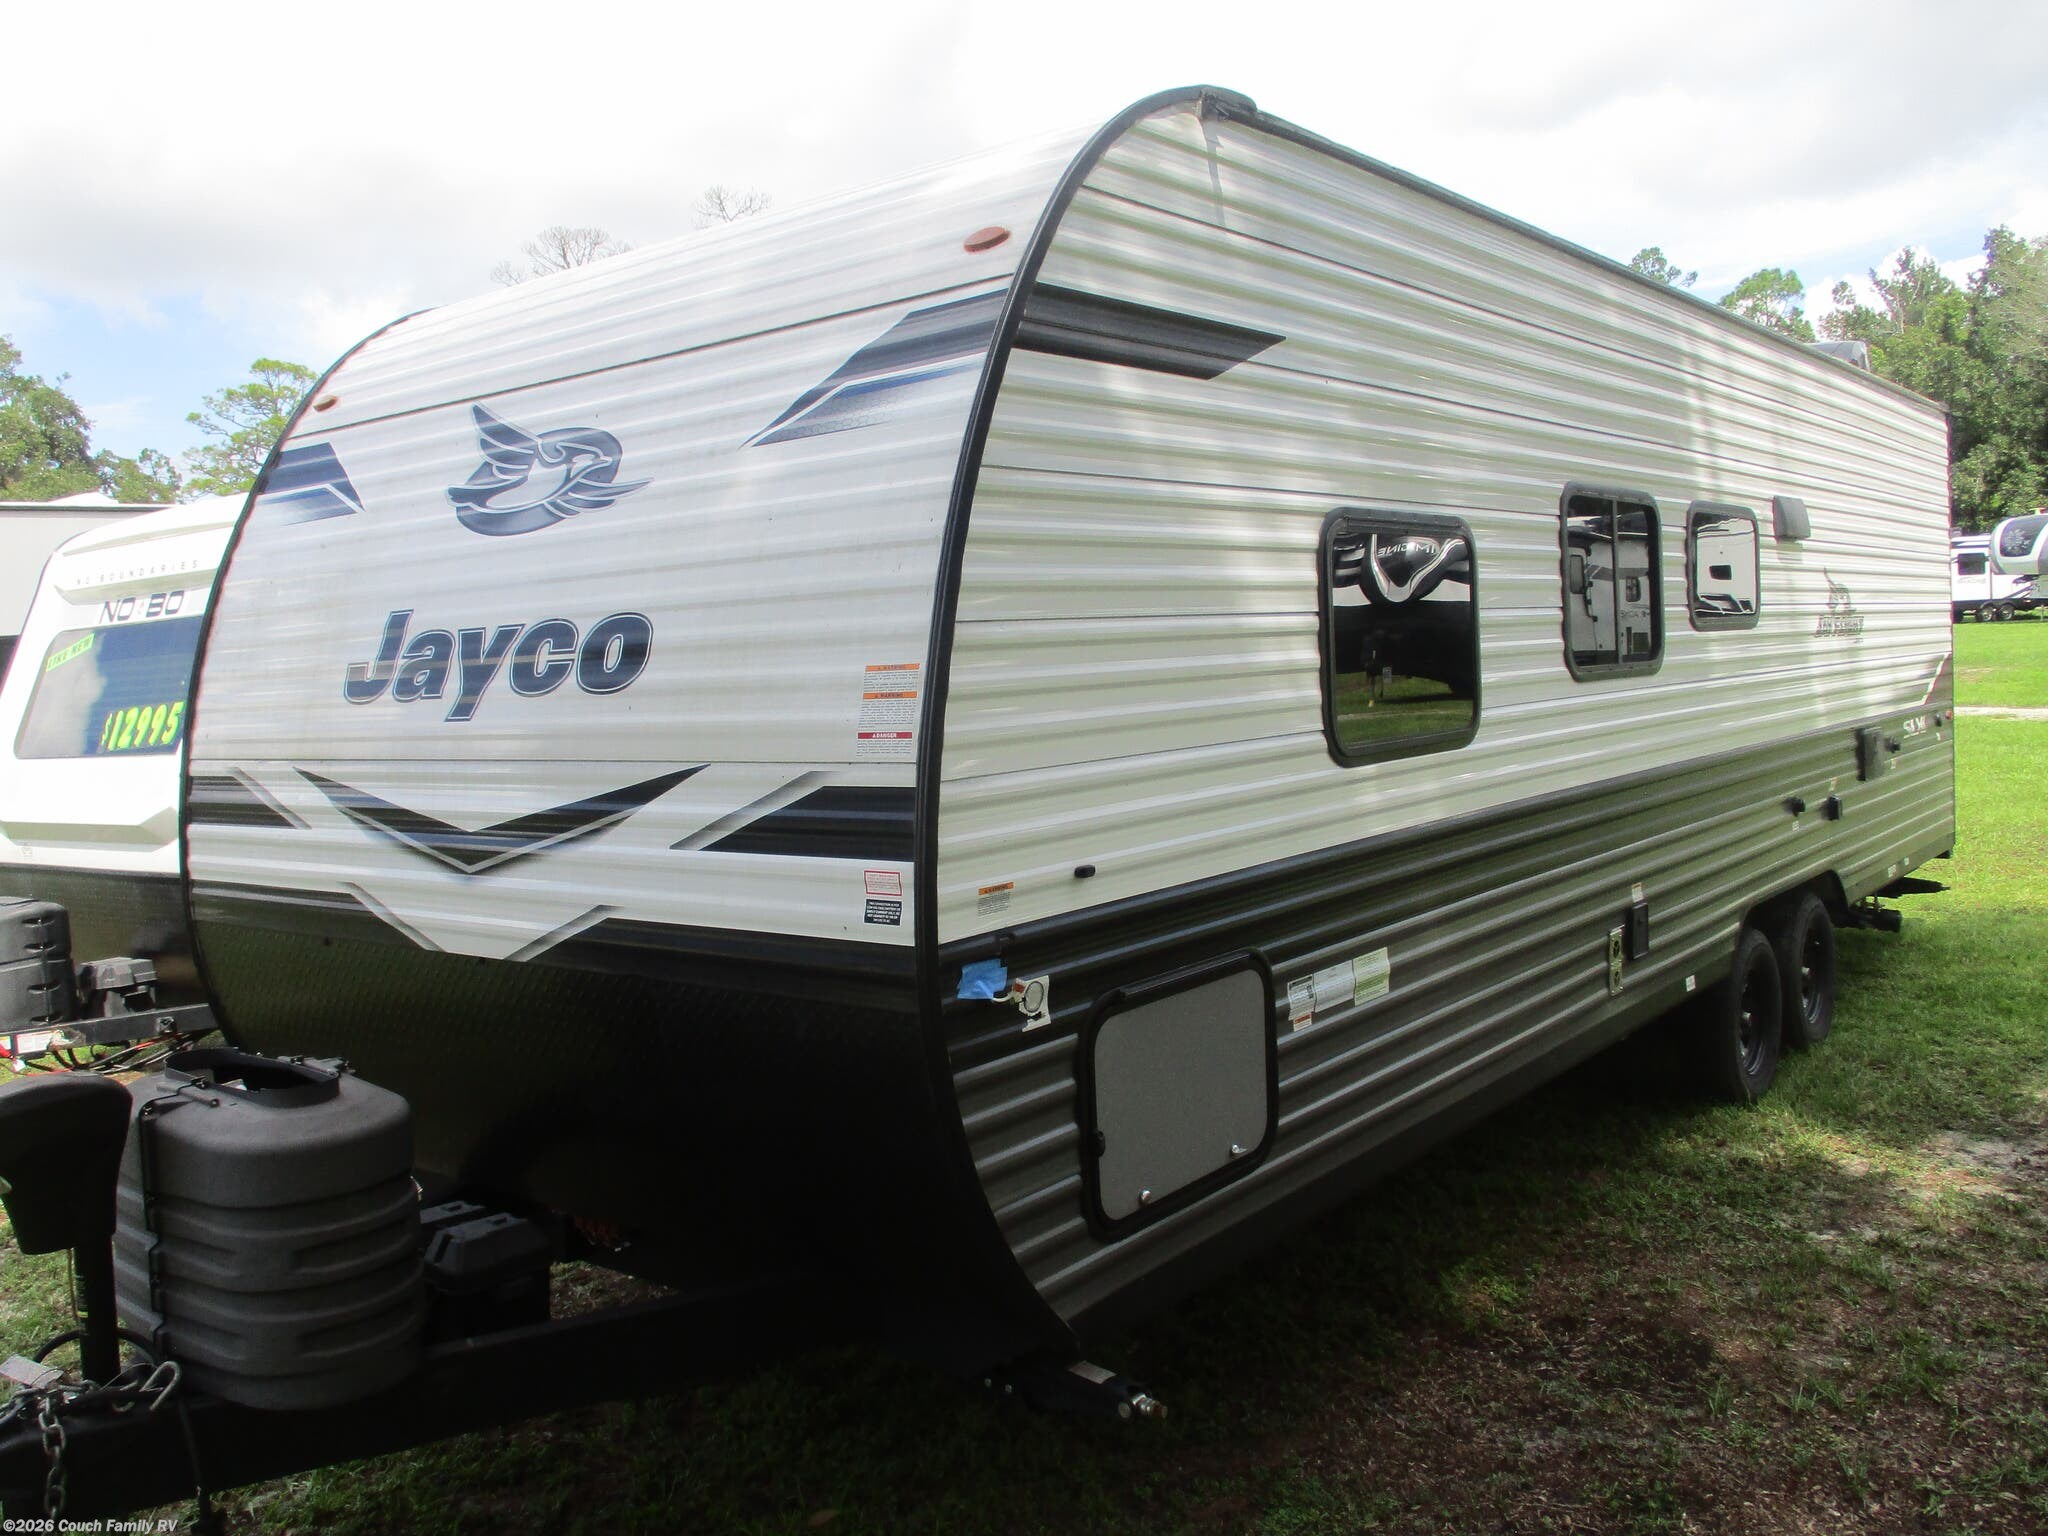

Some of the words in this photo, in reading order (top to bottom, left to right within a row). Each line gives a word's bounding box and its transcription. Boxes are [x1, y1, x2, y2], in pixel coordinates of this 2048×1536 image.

[99, 559, 199, 583] BOUNDARIES
[99, 596, 137, 625] NO
[343, 608, 654, 722] Jayco
[101, 701, 185, 751] $12995
